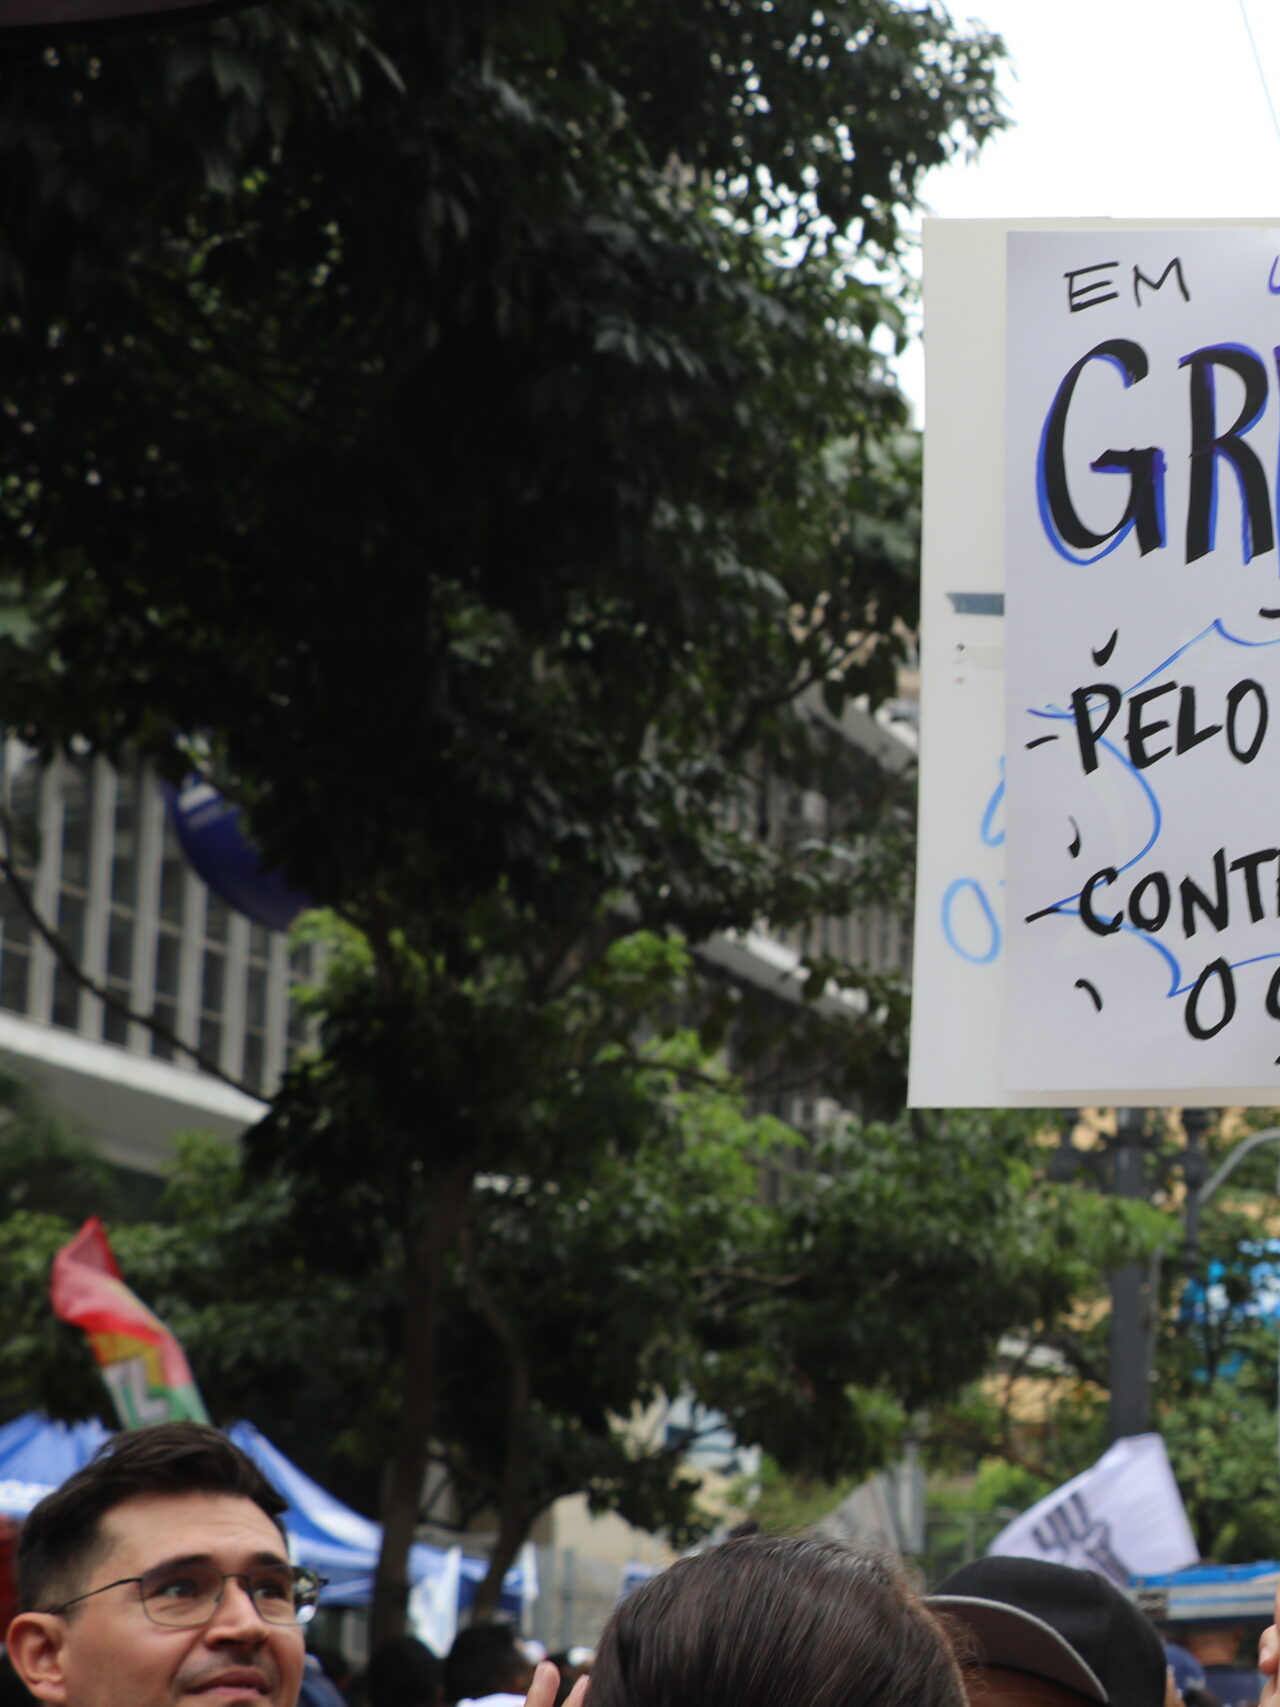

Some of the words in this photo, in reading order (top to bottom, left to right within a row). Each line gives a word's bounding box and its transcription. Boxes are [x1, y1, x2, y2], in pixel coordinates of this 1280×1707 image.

[1064, 257, 1191, 313] EM
[1070, 678, 1269, 774] PELO
[1184, 957, 1237, 1041] O
